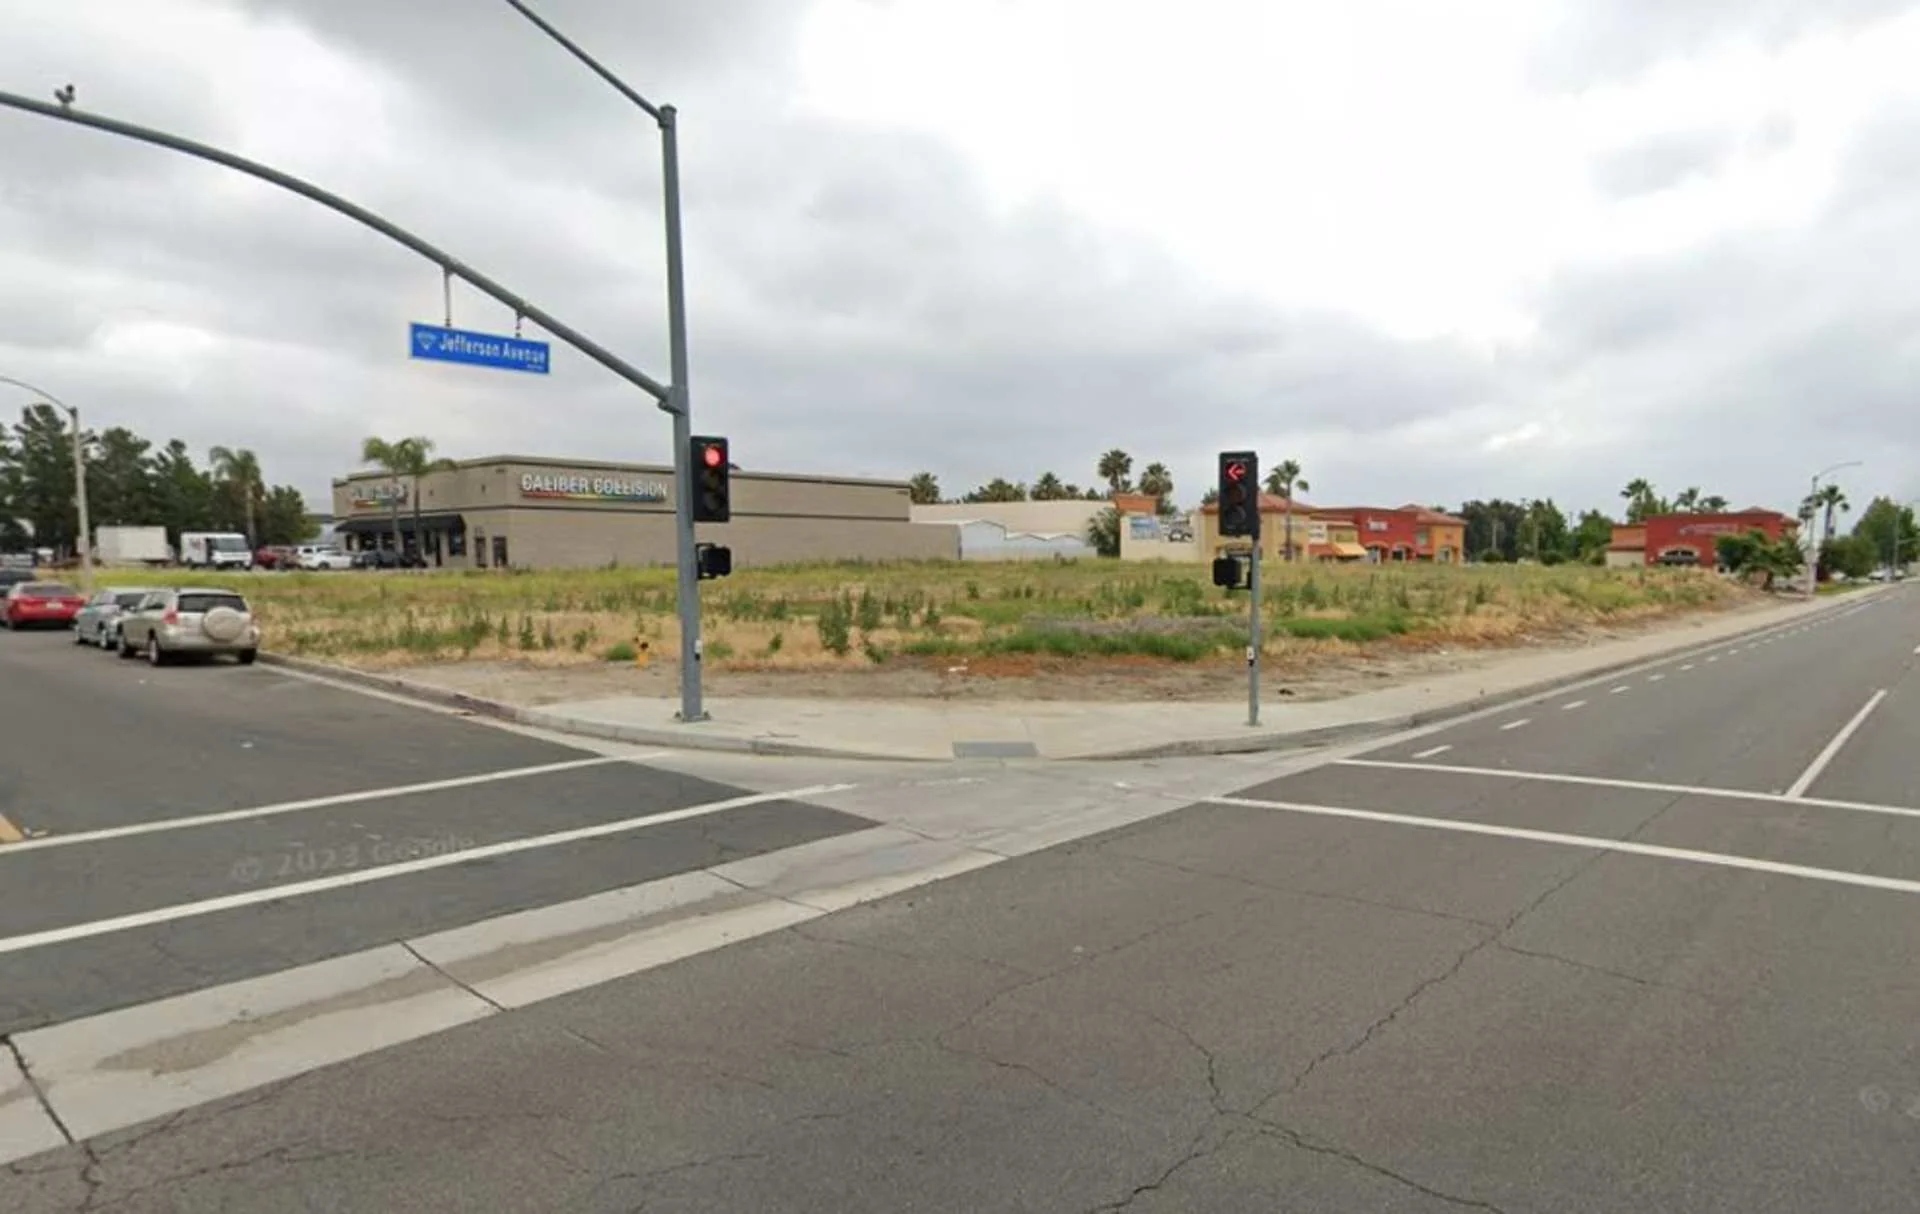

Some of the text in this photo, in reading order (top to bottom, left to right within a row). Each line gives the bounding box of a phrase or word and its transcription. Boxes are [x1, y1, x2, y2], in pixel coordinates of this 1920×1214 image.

[440, 333, 546, 364] Jefferson Avenue
[521, 473, 668, 496] CALIBER COLLISION
